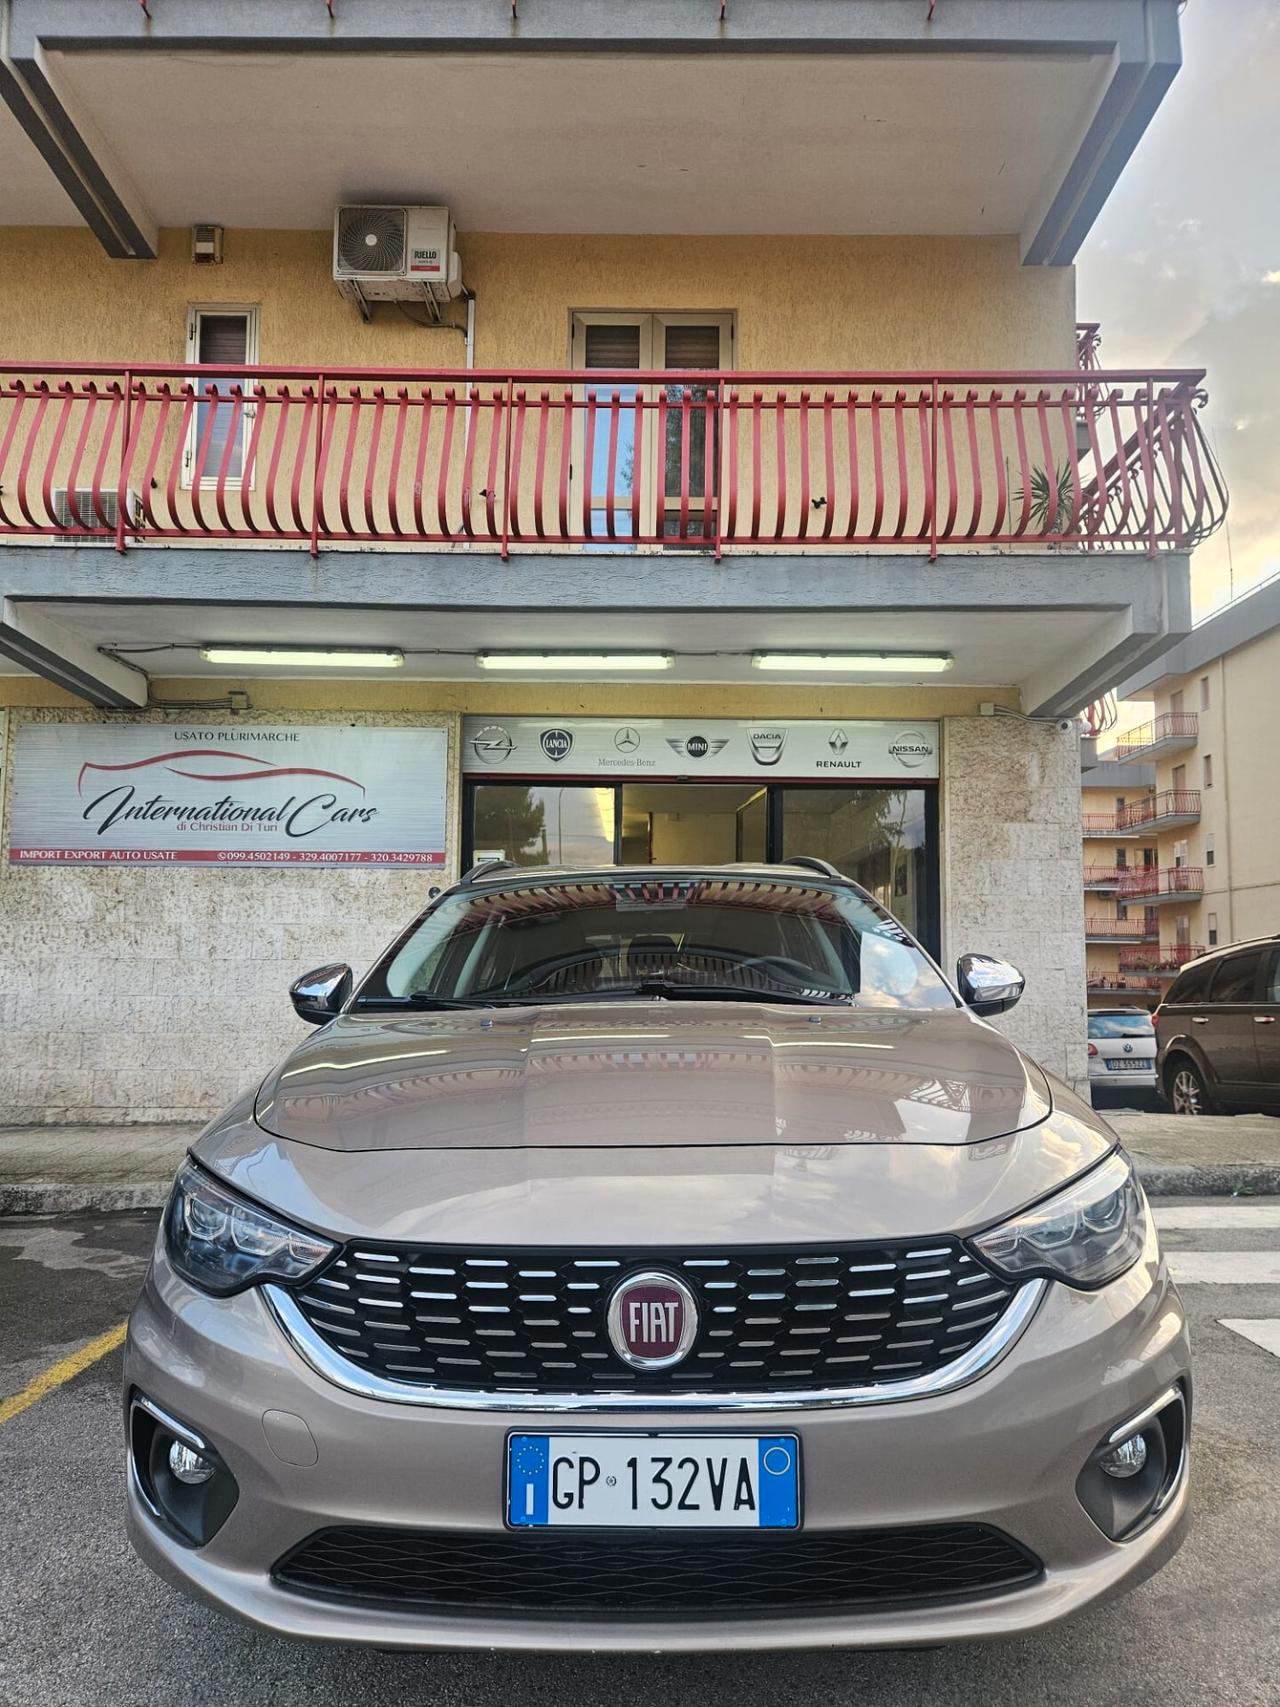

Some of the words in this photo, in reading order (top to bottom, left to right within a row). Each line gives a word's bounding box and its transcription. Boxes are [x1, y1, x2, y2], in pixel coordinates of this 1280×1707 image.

[174, 731, 214, 742] USATO
[217, 731, 300, 743] PLURIMARCHE
[753, 732, 782, 741] DACIA
[545, 739, 569, 749] LANCIA
[687, 742, 708, 751] MINI
[892, 744, 929, 753] NISSAN
[816, 760, 862, 769] RENAULT
[82, 785, 295, 835] International
[285, 793, 380, 838] Cars
[176, 821, 187, 832] di
[190, 821, 238, 832] Christian
[241, 822, 253, 832] Di
[257, 822, 278, 832] Turi
[20, 850, 61, 860] IMPORT
[64, 850, 107, 860] EXPORT
[109, 850, 142, 860] AUTO
[143, 850, 178, 861] USATE
[226, 851, 290, 862] 099.4502149
[299, 852, 362, 863] 329.4007177
[370, 852, 433, 863] 320.3429788
[629, 1302, 679, 1343] FIAT
[552, 1456, 601, 1510] GP
[626, 1457, 757, 1511] 132VA
[525, 1483, 534, 1515] I
